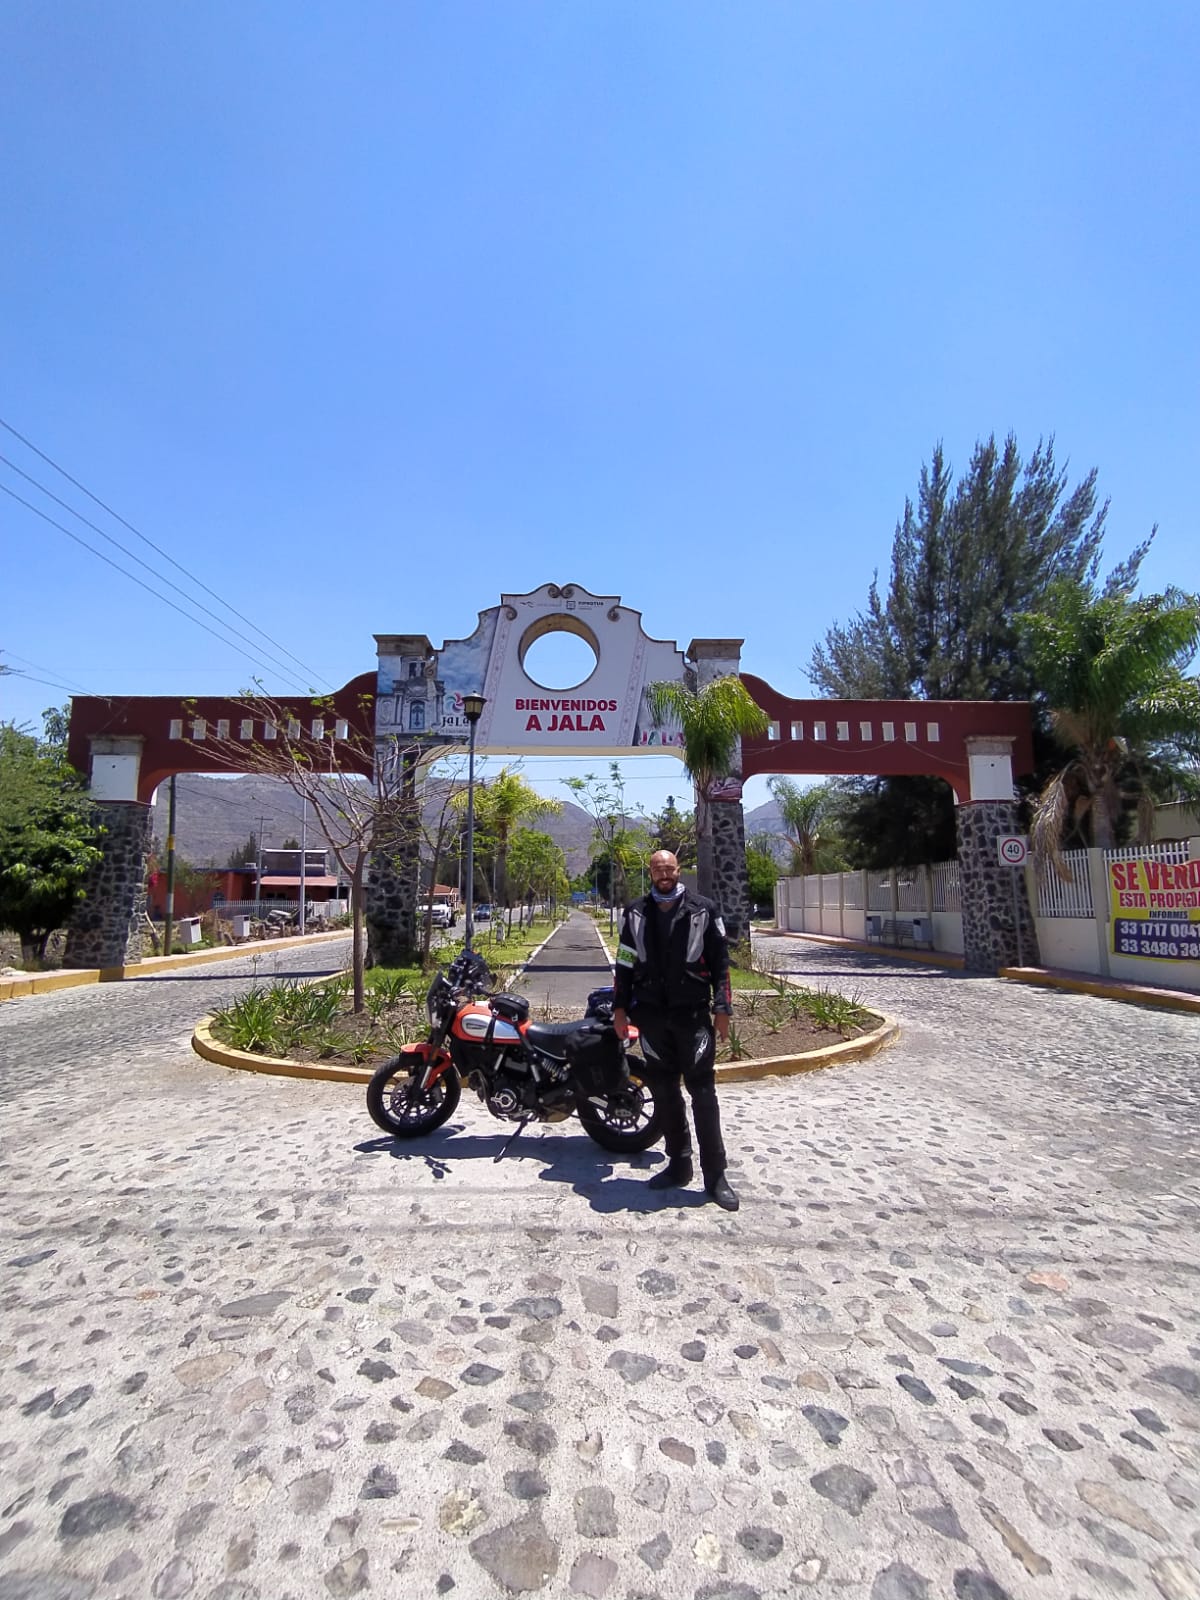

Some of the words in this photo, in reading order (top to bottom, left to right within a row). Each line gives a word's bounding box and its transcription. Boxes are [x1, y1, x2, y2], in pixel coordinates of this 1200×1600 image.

[515, 699, 617, 711] BIENVENIDOS
[525, 714, 542, 731] A
[547, 714, 606, 731] JALA
[1007, 844, 1020, 855] 40
[1111, 862, 1140, 890] SE
[1119, 892, 1147, 908] ESTA
[1149, 910, 1188, 919] INFORMES
[1120, 921, 1137, 934] 33
[1140, 922, 1168, 937] 1717
[1121, 938, 1138, 952] 33
